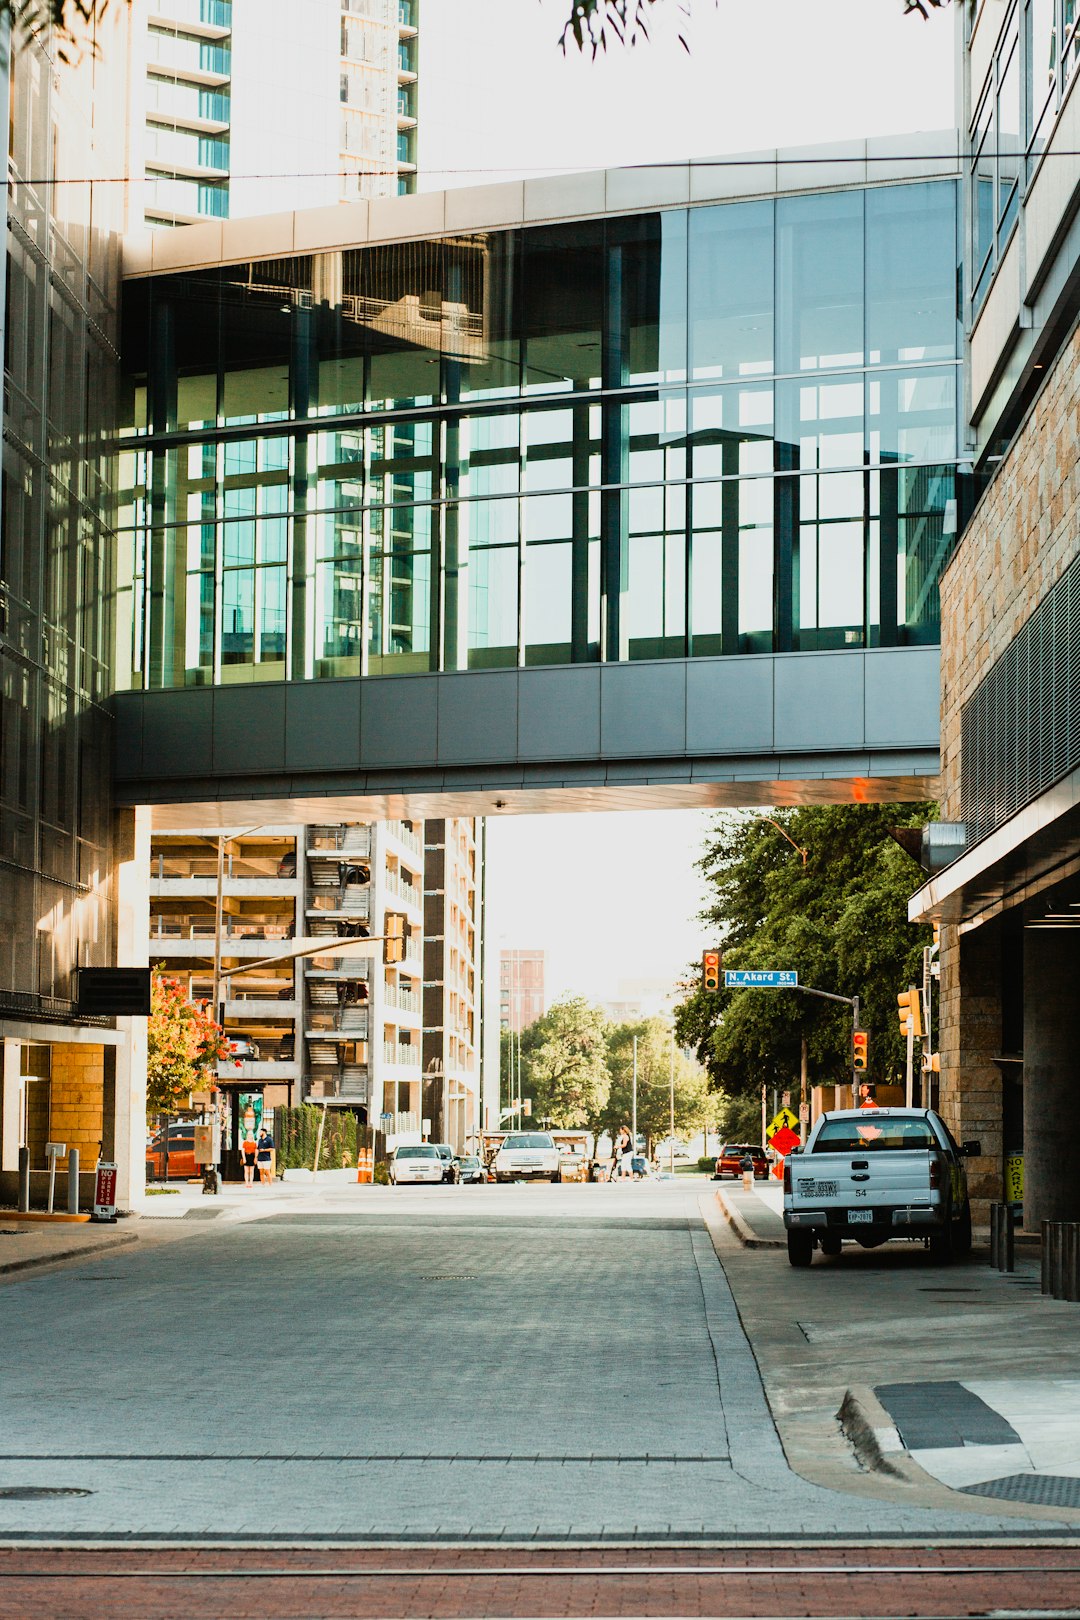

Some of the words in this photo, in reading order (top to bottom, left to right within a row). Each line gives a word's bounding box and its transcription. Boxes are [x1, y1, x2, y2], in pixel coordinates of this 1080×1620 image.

[729, 973, 739, 981] N.
[743, 973, 774, 981] Akard
[779, 973, 793, 981] St.
[1007, 1158, 1022, 1167] NO
[1010, 1167, 1023, 1199] PARKING
[855, 1189, 867, 1197] 54
